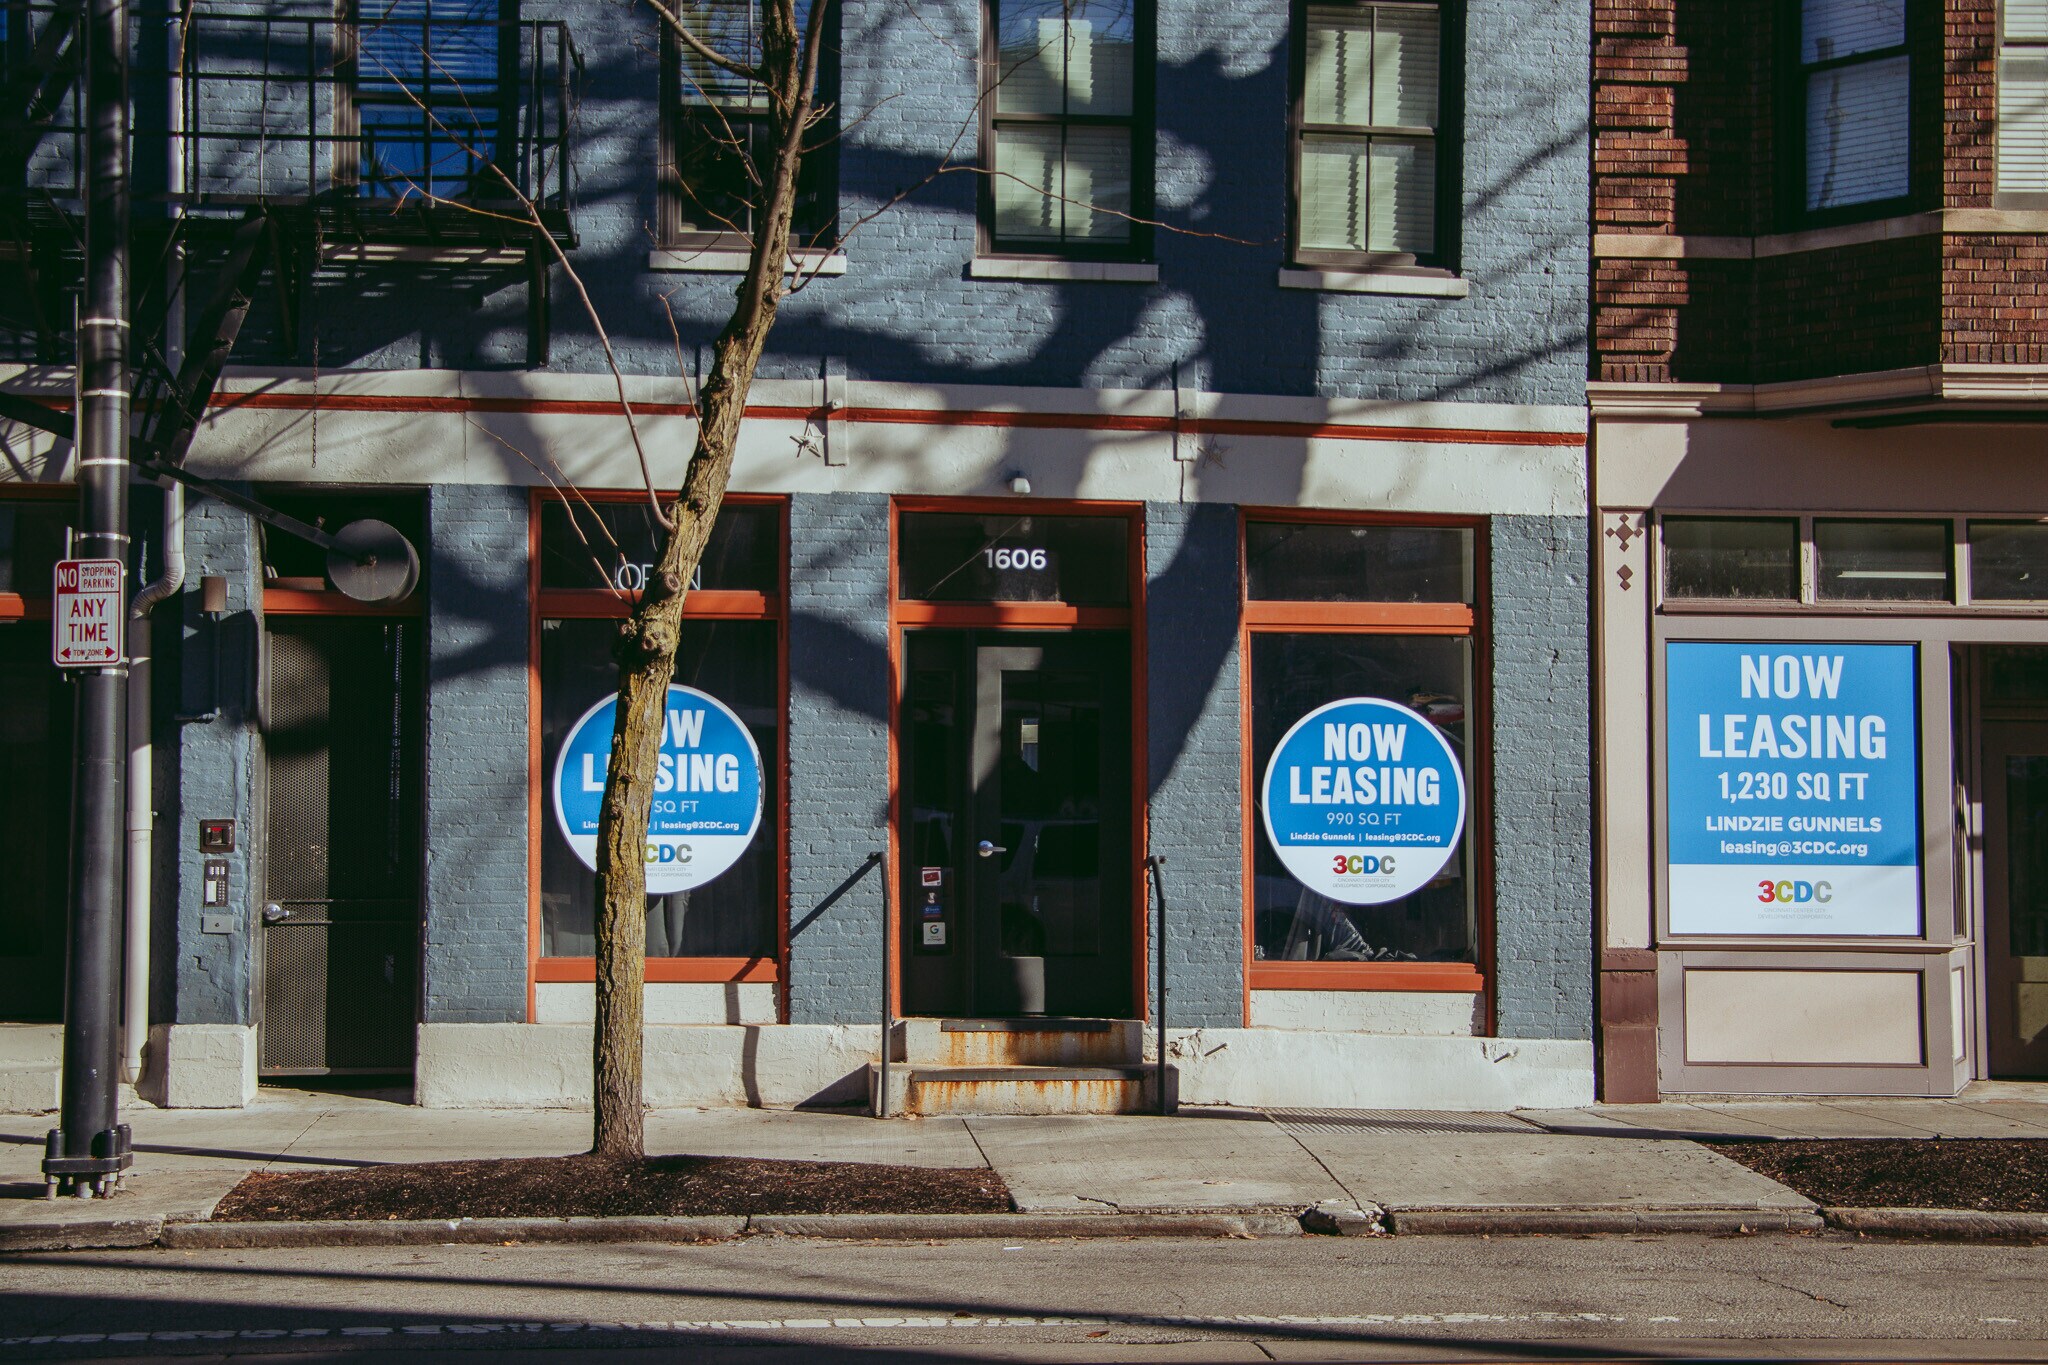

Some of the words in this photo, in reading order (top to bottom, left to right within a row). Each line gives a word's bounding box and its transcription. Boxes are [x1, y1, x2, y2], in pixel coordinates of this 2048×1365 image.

[985, 548, 1047, 570] 1606
[59, 568, 77, 588] NO
[82, 566, 117, 577] STOPPING
[83, 579, 115, 589] PARKING
[70, 599, 107, 617] ANY
[68, 623, 109, 642] TIME
[87, 648, 103, 656] ZONE
[1741, 655, 1844, 699] NOW
[1324, 723, 1407, 762] NOW
[1699, 714, 1887, 760] LEASING
[583, 753, 740, 793] LSING
[1289, 766, 1440, 805] LEASING
[1718, 771, 1788, 803] 1,230
[1796, 772, 1831, 802] SQ
[1839, 772, 1869, 800] FT
[654, 800, 677, 814] SQ
[681, 800, 700, 813] FT
[661, 820, 740, 831] leasing@3CDC.org
[1326, 812, 1354, 825] 990
[1358, 812, 1380, 826] SQ
[1384, 813, 1402, 825] FT
[1706, 815, 1784, 832] LINDZIE
[1787, 816, 1883, 833] GUNNELS
[1290, 832, 1320, 841] Lindzie
[1322, 832, 1355, 841] Gunnels
[1365, 832, 1441, 843] leasing@3CDC.org
[643, 843, 693, 864] CDC
[1720, 840, 1868, 857] leasing@3CDC.org
[1332, 855, 1396, 875] 3CDC
[1757, 879, 1833, 904] 3CDC
